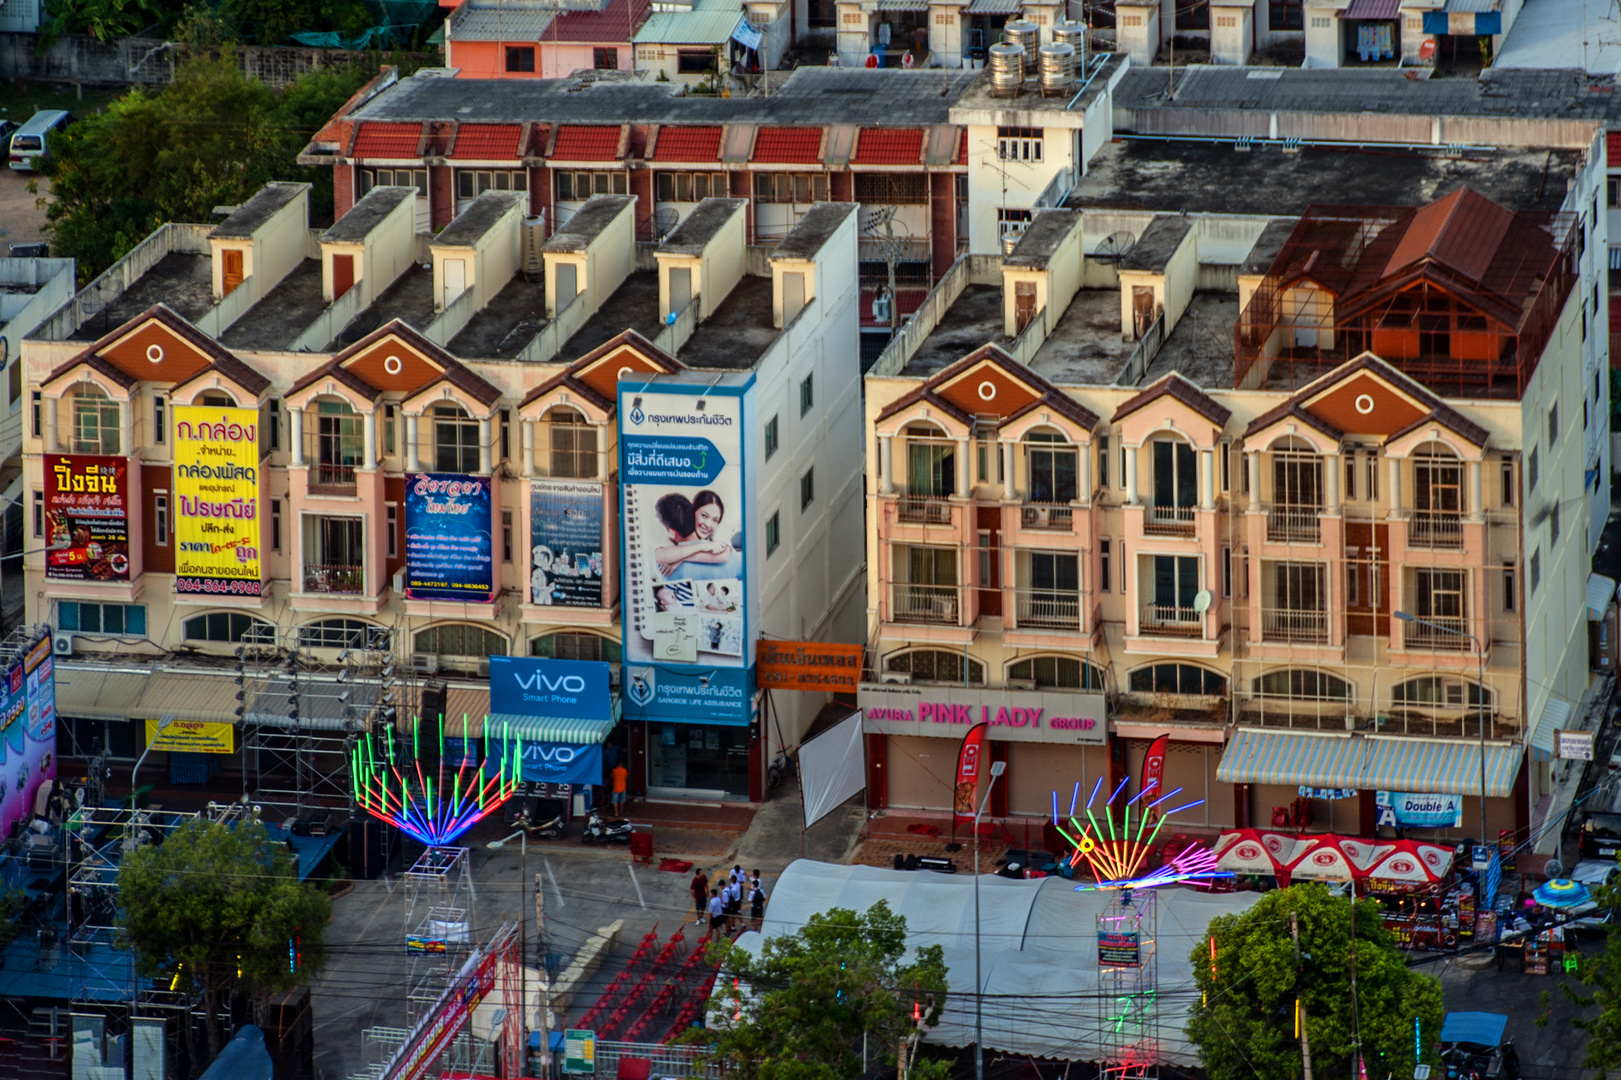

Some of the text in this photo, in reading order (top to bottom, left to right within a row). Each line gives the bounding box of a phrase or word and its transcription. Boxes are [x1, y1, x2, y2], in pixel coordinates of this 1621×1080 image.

[648, 413, 732, 427] กรุงเทพประกันชีวิต
[177, 416, 256, 442] ก.กล่อง
[627, 450, 691, 468] มีสิ่งที่ดีเสมอ
[54, 457, 117, 493] ปิ้งจีน
[178, 460, 256, 486] กล่องพัสดุ
[179, 496, 256, 520] ไปรษณีย์
[69, 552, 75, 560] 5
[180, 540, 210, 552] ราคา
[236, 546, 257, 563] ถูก
[178, 561, 259, 577] เพื่อคนขายออนไลน์
[178, 579, 260, 595] 064-564-9968
[514, 668, 585, 693] vivo
[522, 692, 577, 704] Smart Phone
[657, 684, 742, 698] กรุงเทพประกันชีวิต
[657, 697, 742, 708] BANGKOK LIFE ASSURANCE
[868, 702, 1096, 731] AYURA PINK LADY GROUP
[544, 763, 567, 772] Phone
[962, 744, 979, 776] LEO
[1405, 801, 1455, 812] Double A
